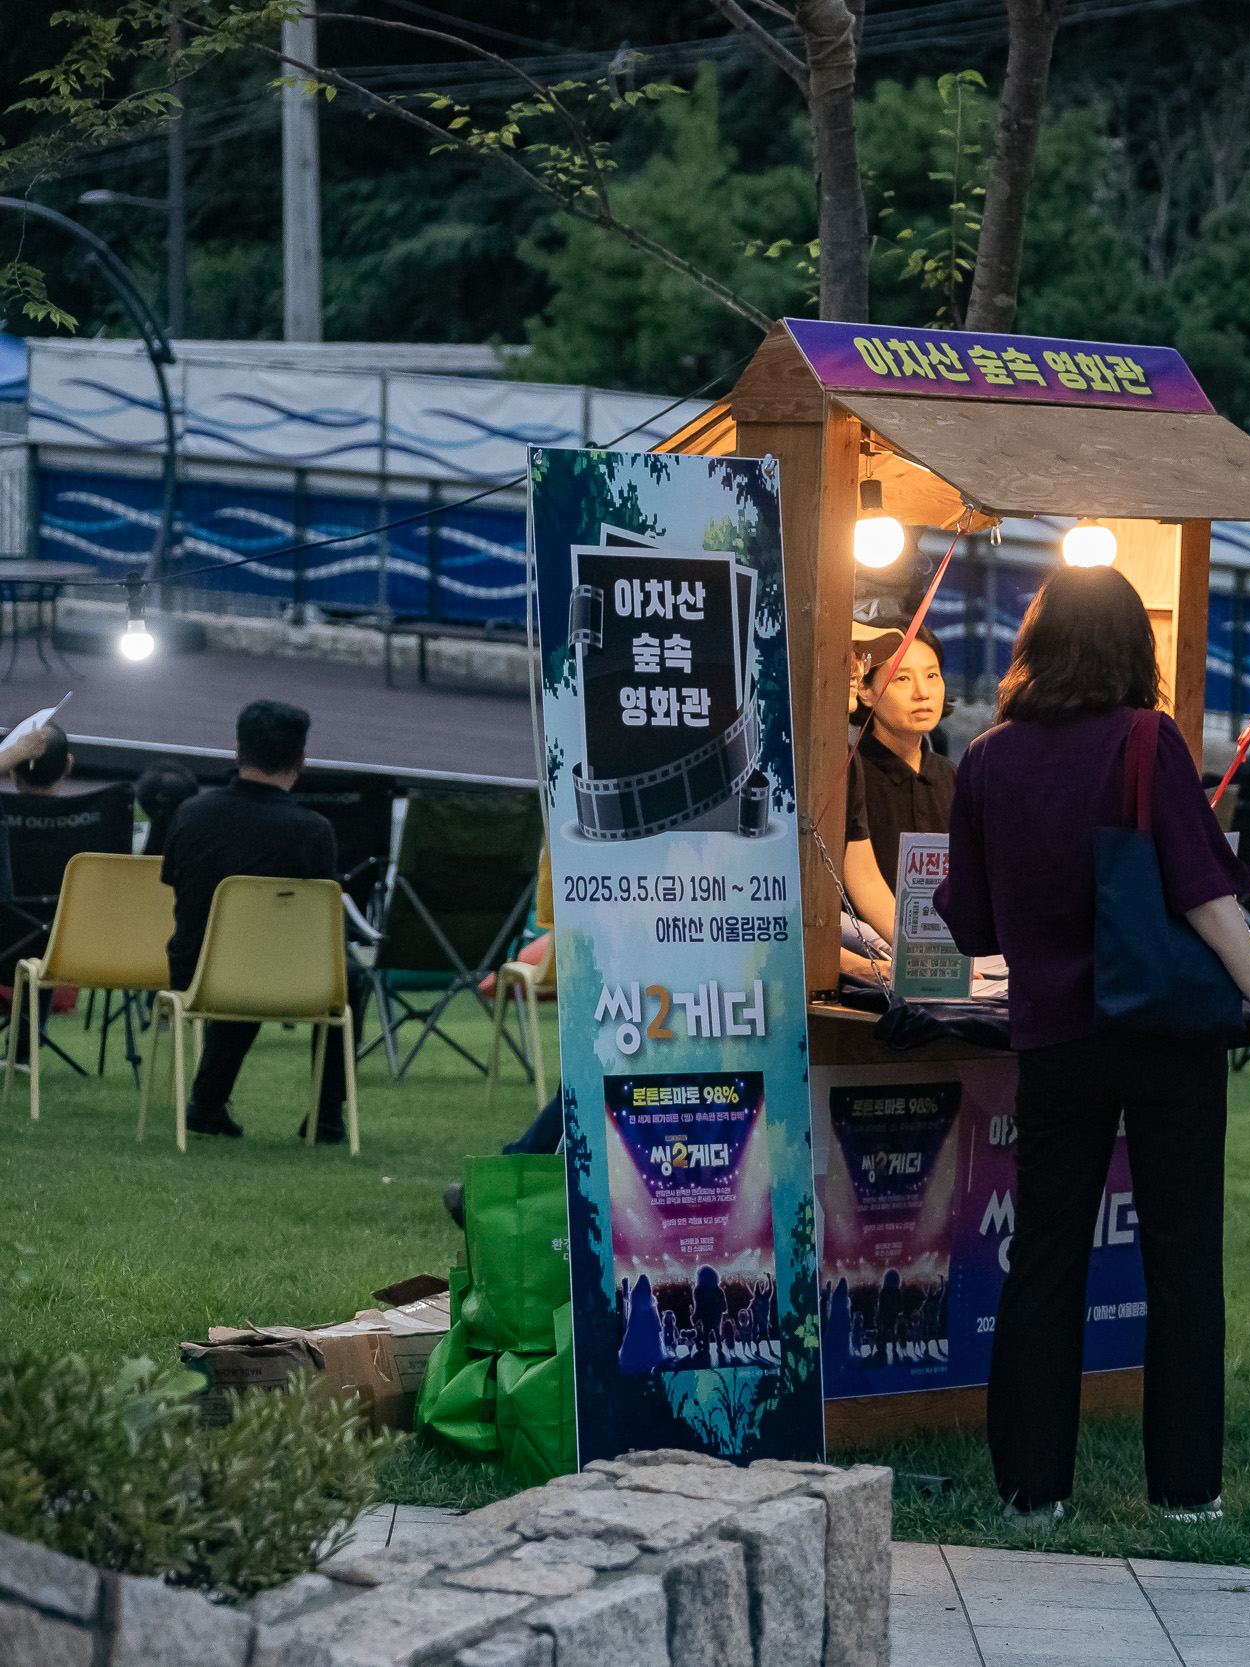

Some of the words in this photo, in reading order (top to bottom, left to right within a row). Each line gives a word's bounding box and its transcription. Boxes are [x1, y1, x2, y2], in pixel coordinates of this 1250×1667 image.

[853, 337, 970, 382] 아차산
[967, 344, 1047, 387] 숲속
[1043, 351, 1152, 395] 영화관
[614, 578, 706, 620] 아차산
[632, 633, 692, 674] 숲속
[619, 686, 711, 727] 영화관
[564, 875, 685, 902] 2025.9.5.(금)
[690, 875, 727, 902] 19시
[750, 875, 787, 902] 21시
[656, 916, 704, 943] 아차산
[710, 916, 789, 942] 어울림광장
[594, 979, 766, 1055] 씽2게더
[633, 1086, 700, 1106] 로튼토마토
[703, 1086, 739, 1104] 98%
[852, 1098, 906, 1116] 로튼토마토
[908, 1098, 938, 1114] 98%
[650, 1142, 729, 1176] 씽2게더
[1093, 1304, 1116, 1321] 아차산
[1117, 1300, 1148, 1319] 어울림광
